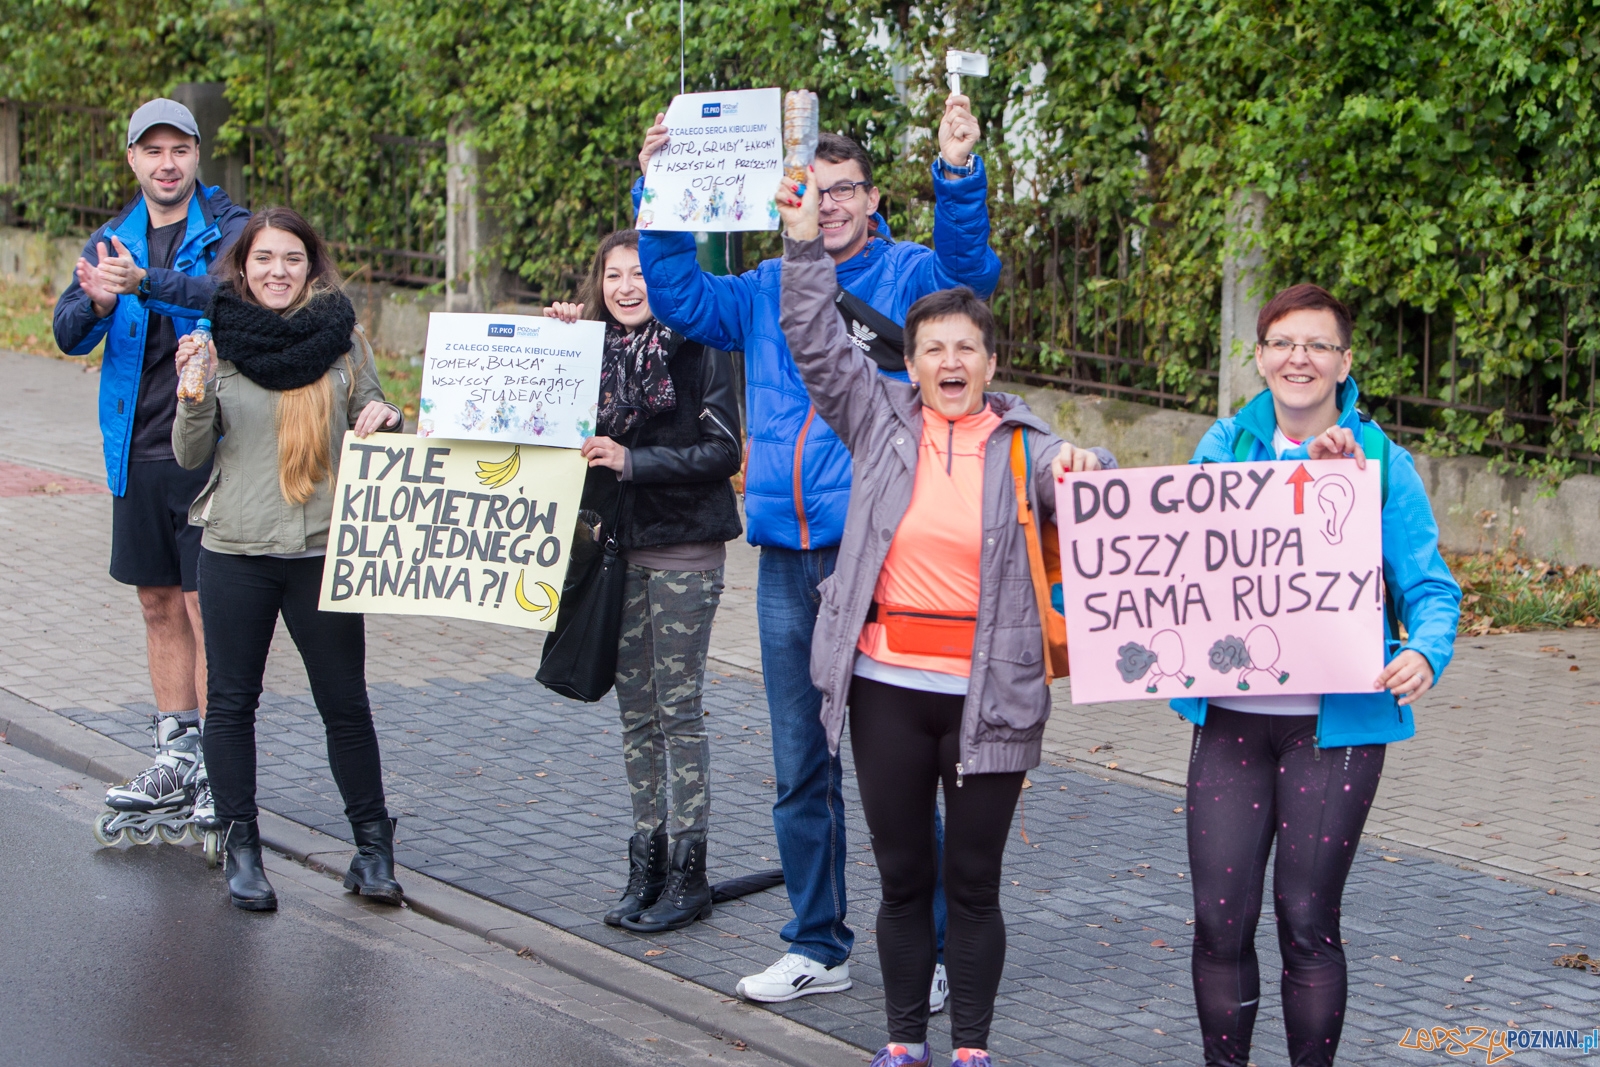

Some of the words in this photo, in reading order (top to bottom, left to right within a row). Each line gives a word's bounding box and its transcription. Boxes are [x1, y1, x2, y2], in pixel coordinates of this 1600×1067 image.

[669, 128, 674, 136] Z
[675, 126, 704, 136] CAŁEGO
[705, 126, 727, 135] SERCA
[728, 124, 767, 133] KIBICUJEMY
[653, 160, 663, 172] +
[692, 174, 746, 191] OJCOM
[445, 343, 451, 351] Z
[453, 343, 489, 352] CAŁEGO
[491, 344, 523, 354] SERCA
[525, 346, 582, 358] KIBICUJEMY
[430, 357, 480, 370] TOMEK
[554, 364, 567, 375] +
[432, 375, 493, 387] WSZYSCY
[349, 443, 452, 485] TYLE
[340, 484, 558, 535] KILOMETRÓW
[1072, 478, 1131, 525] DO
[1150, 464, 1275, 514] GÓRY
[336, 524, 404, 559] DLA
[411, 523, 562, 568] JEDNEGO
[1205, 527, 1304, 572] DUPA
[1084, 582, 1212, 633] SAMA
[1232, 565, 1383, 621] RUSZY!
